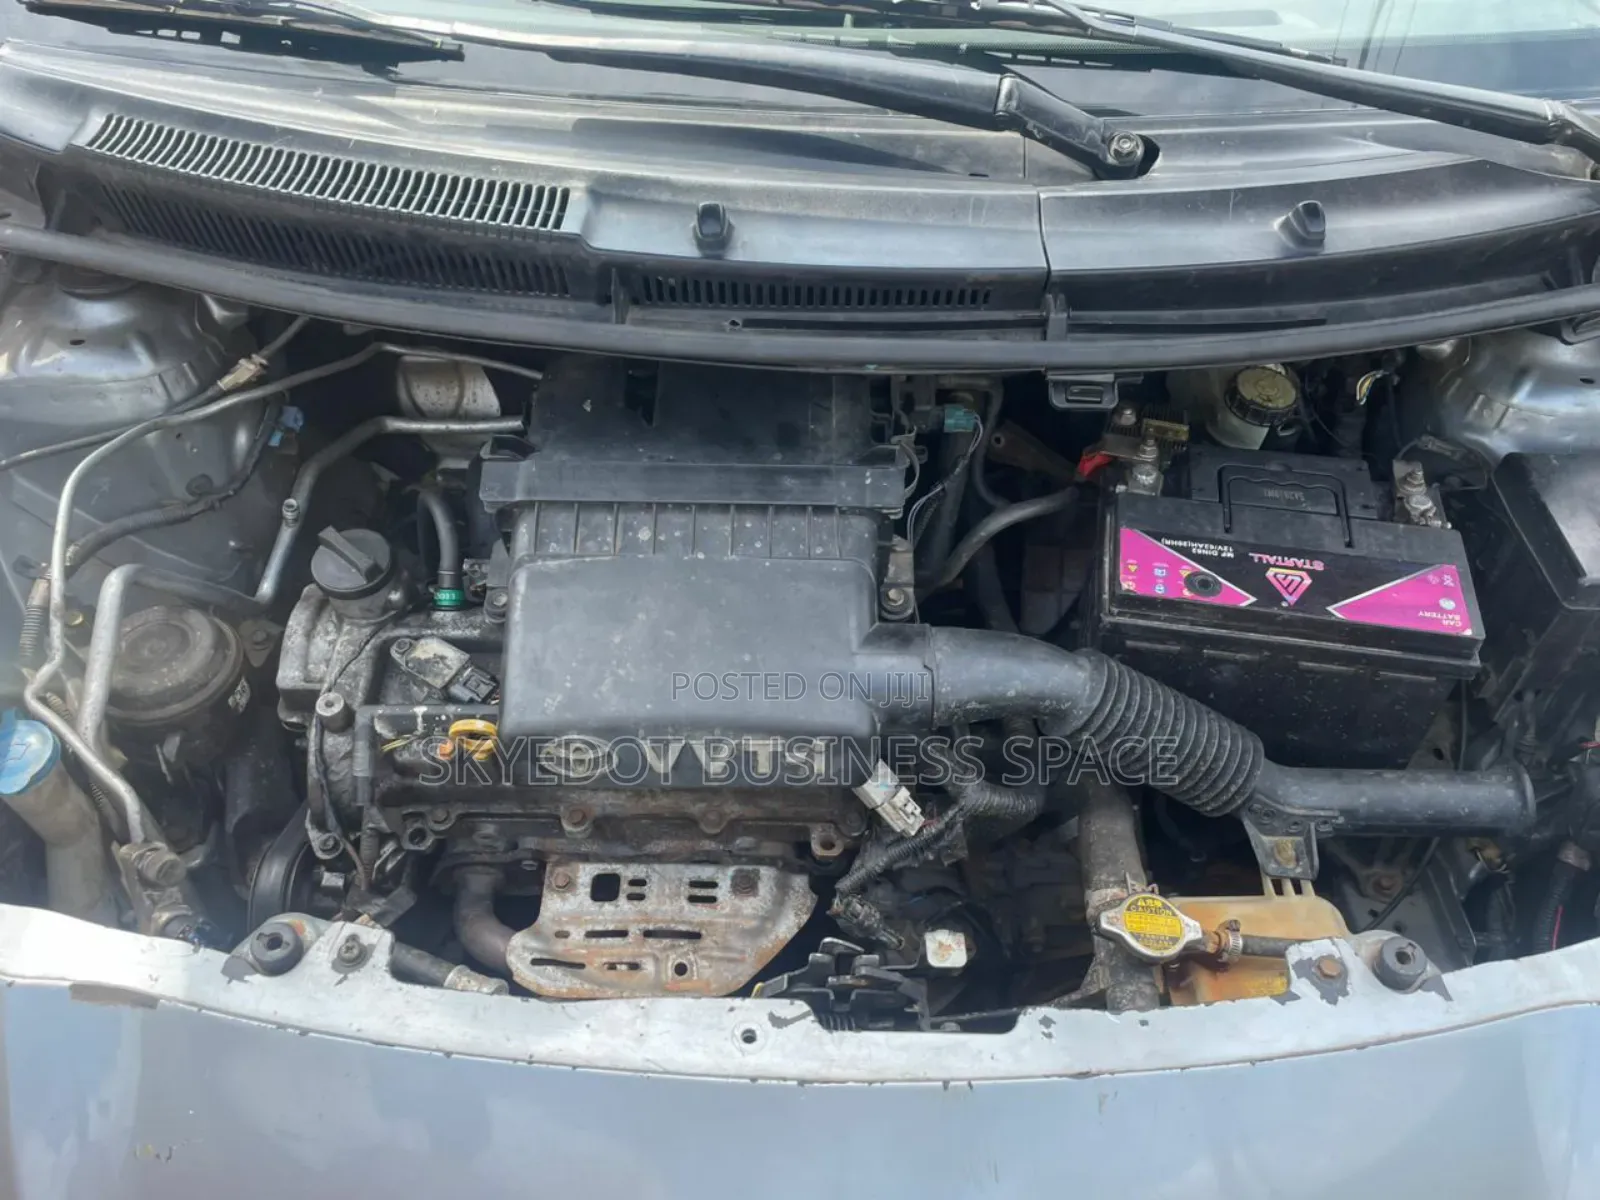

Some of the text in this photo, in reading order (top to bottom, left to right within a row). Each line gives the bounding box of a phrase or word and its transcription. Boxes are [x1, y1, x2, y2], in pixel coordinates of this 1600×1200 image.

[1248, 552, 1325, 571] STARTALL
[1417, 610, 1461, 621] BATTERY
[1442, 619, 1462, 627] CAR
[1130, 905, 1173, 916] CAUTION
